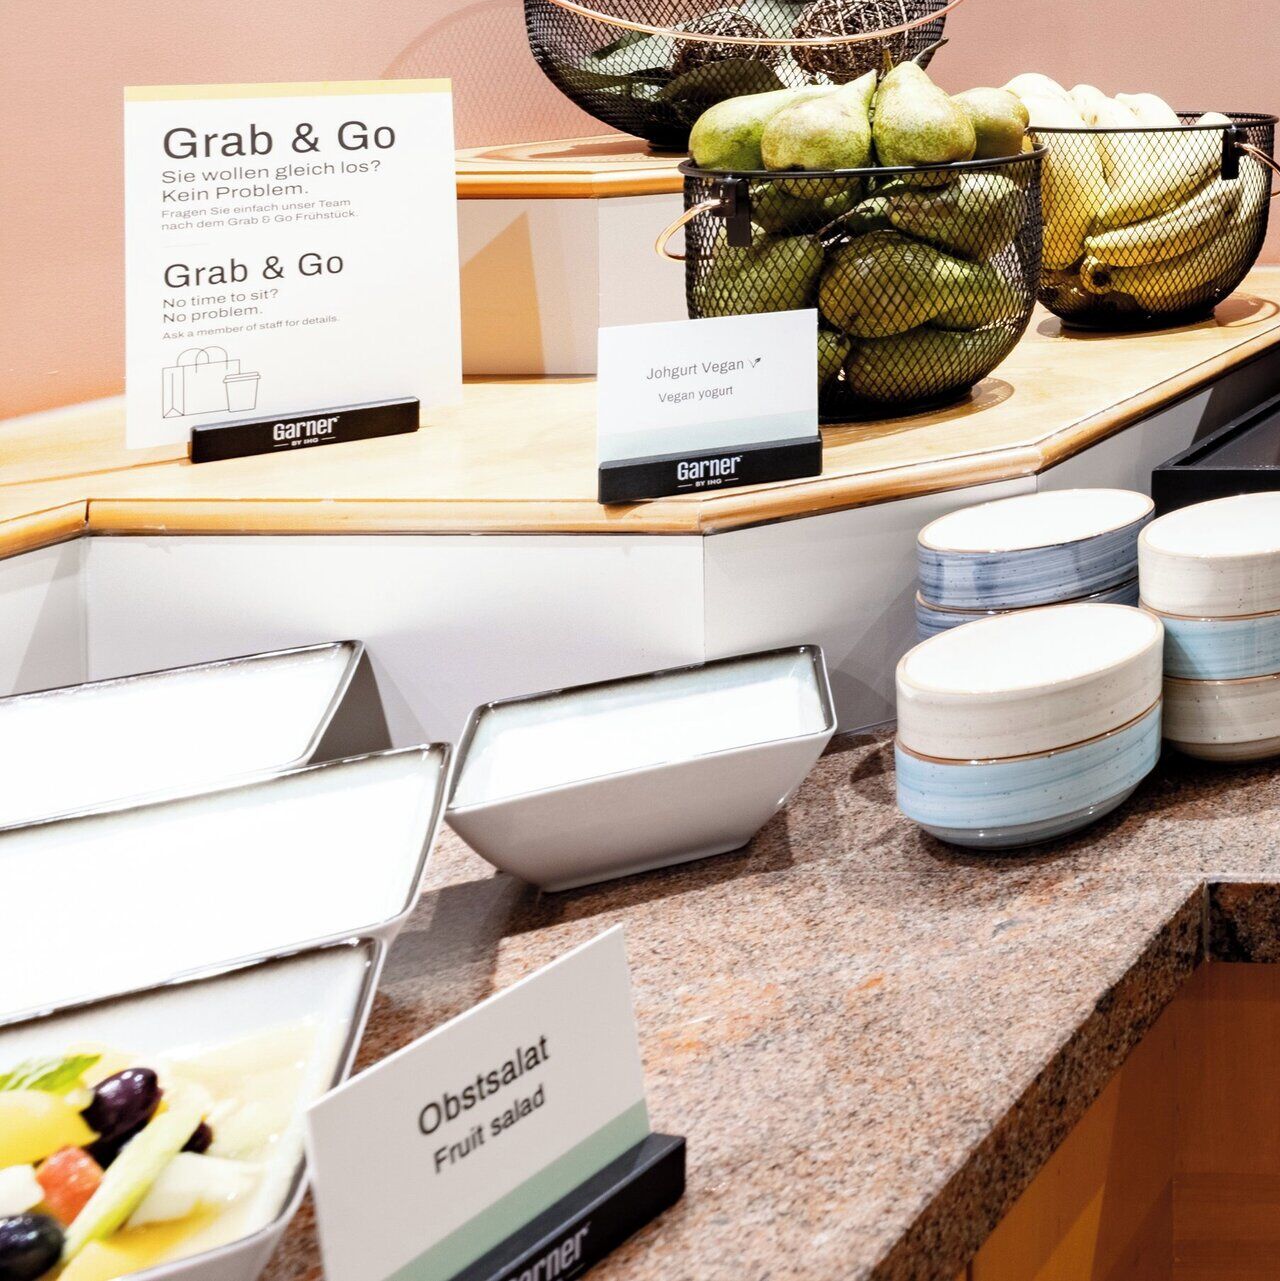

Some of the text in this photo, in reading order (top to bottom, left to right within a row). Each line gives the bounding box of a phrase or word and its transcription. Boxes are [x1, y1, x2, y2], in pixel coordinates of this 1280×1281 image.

[163, 120, 396, 159] Grab & Go
[162, 160, 381, 184] Sie wollen gleich los?
[162, 184, 309, 203] Kein Problem.
[161, 199, 352, 219] Fragen Sie einfach unser Team
[161, 221, 193, 231] nach
[196, 219, 224, 229] dem
[227, 216, 258, 226] Grab
[274, 215, 293, 223] Go
[163, 252, 344, 289] Grab & Go
[162, 288, 279, 309] No time to sit?
[162, 306, 263, 324] No problem.
[162, 331, 185, 340] Ask
[196, 325, 243, 336] member
[246, 322, 257, 332] of
[259, 320, 283, 330] staff
[285, 319, 300, 328] for
[646, 358, 744, 380] Johgurt Vegan
[658, 386, 733, 404] Vegan yogurt
[273, 417, 338, 440] Garner
[677, 457, 740, 480] Garner
[418, 1035, 550, 1137] Obstsalat
[433, 1084, 546, 1174] Fruit salad
[509, 1227, 588, 1281] rner
